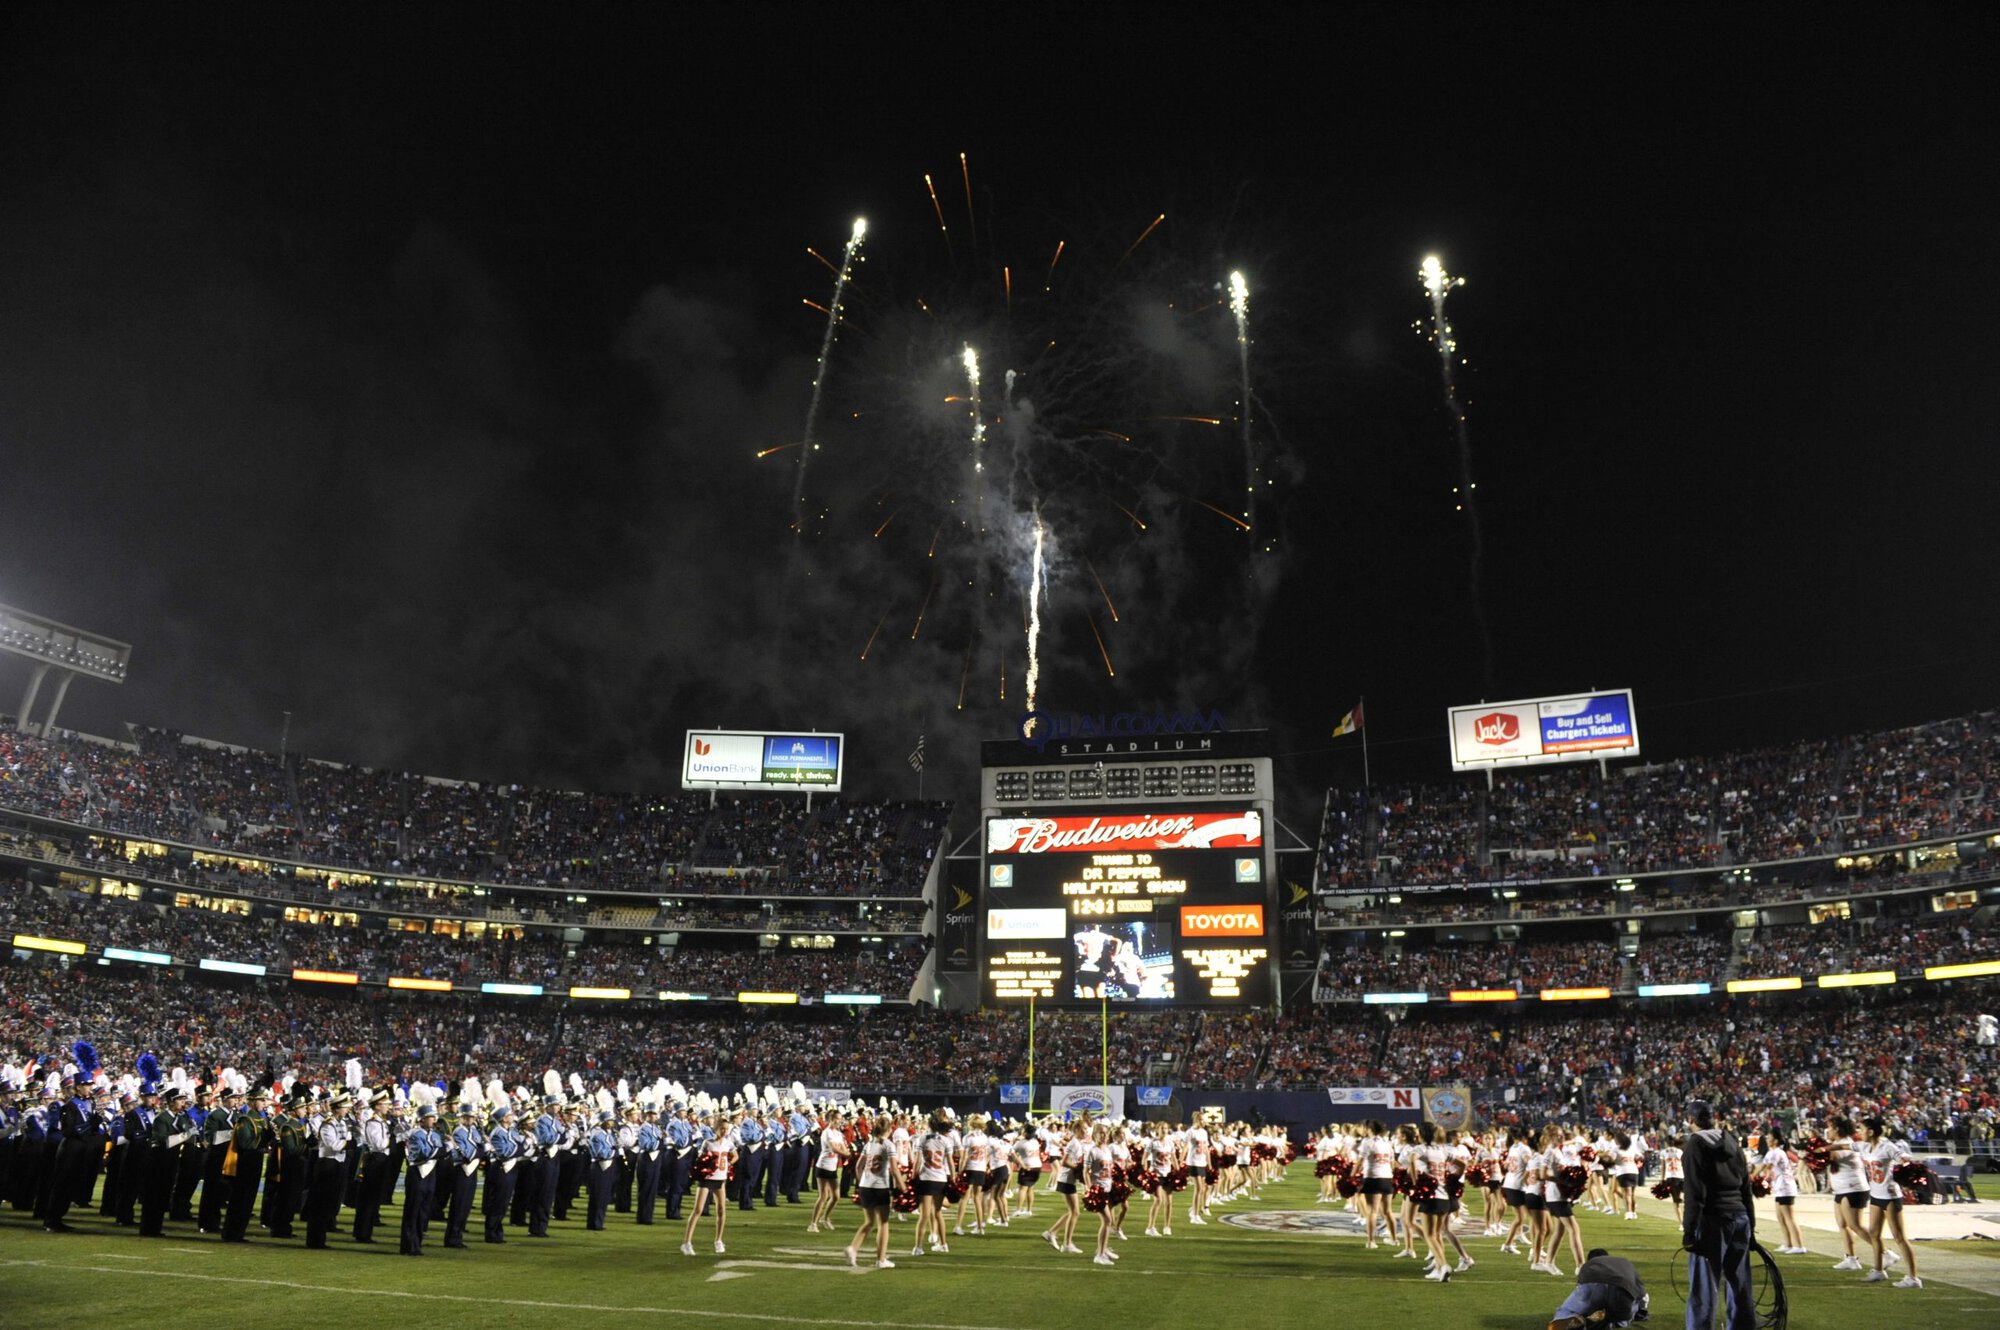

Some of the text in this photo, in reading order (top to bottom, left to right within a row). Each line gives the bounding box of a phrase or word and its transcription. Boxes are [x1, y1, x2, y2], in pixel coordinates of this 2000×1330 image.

[1557, 713, 1612, 728] Buy and Sell
[1018, 710, 1226, 752] QUALCOMM
[1476, 715, 1518, 743] Jack
[1546, 723, 1626, 740] Chargers Tickets!
[1061, 739, 1211, 754] STADIUM
[766, 772, 789, 780] ready.
[806, 771, 833, 780] thrive.
[1022, 815, 1194, 853] Budweiser
[1137, 854, 1152, 865] TO
[1083, 866, 1161, 880] DR PEPPER
[1147, 880, 1186, 894] SHOW
[945, 913, 975, 925] Sprint
[1184, 913, 1259, 929] TOYOTA
[1280, 909, 1312, 922] Sprint
[1068, 1091, 1093, 1102] PACIFIC
[1393, 1090, 1413, 1107] N
